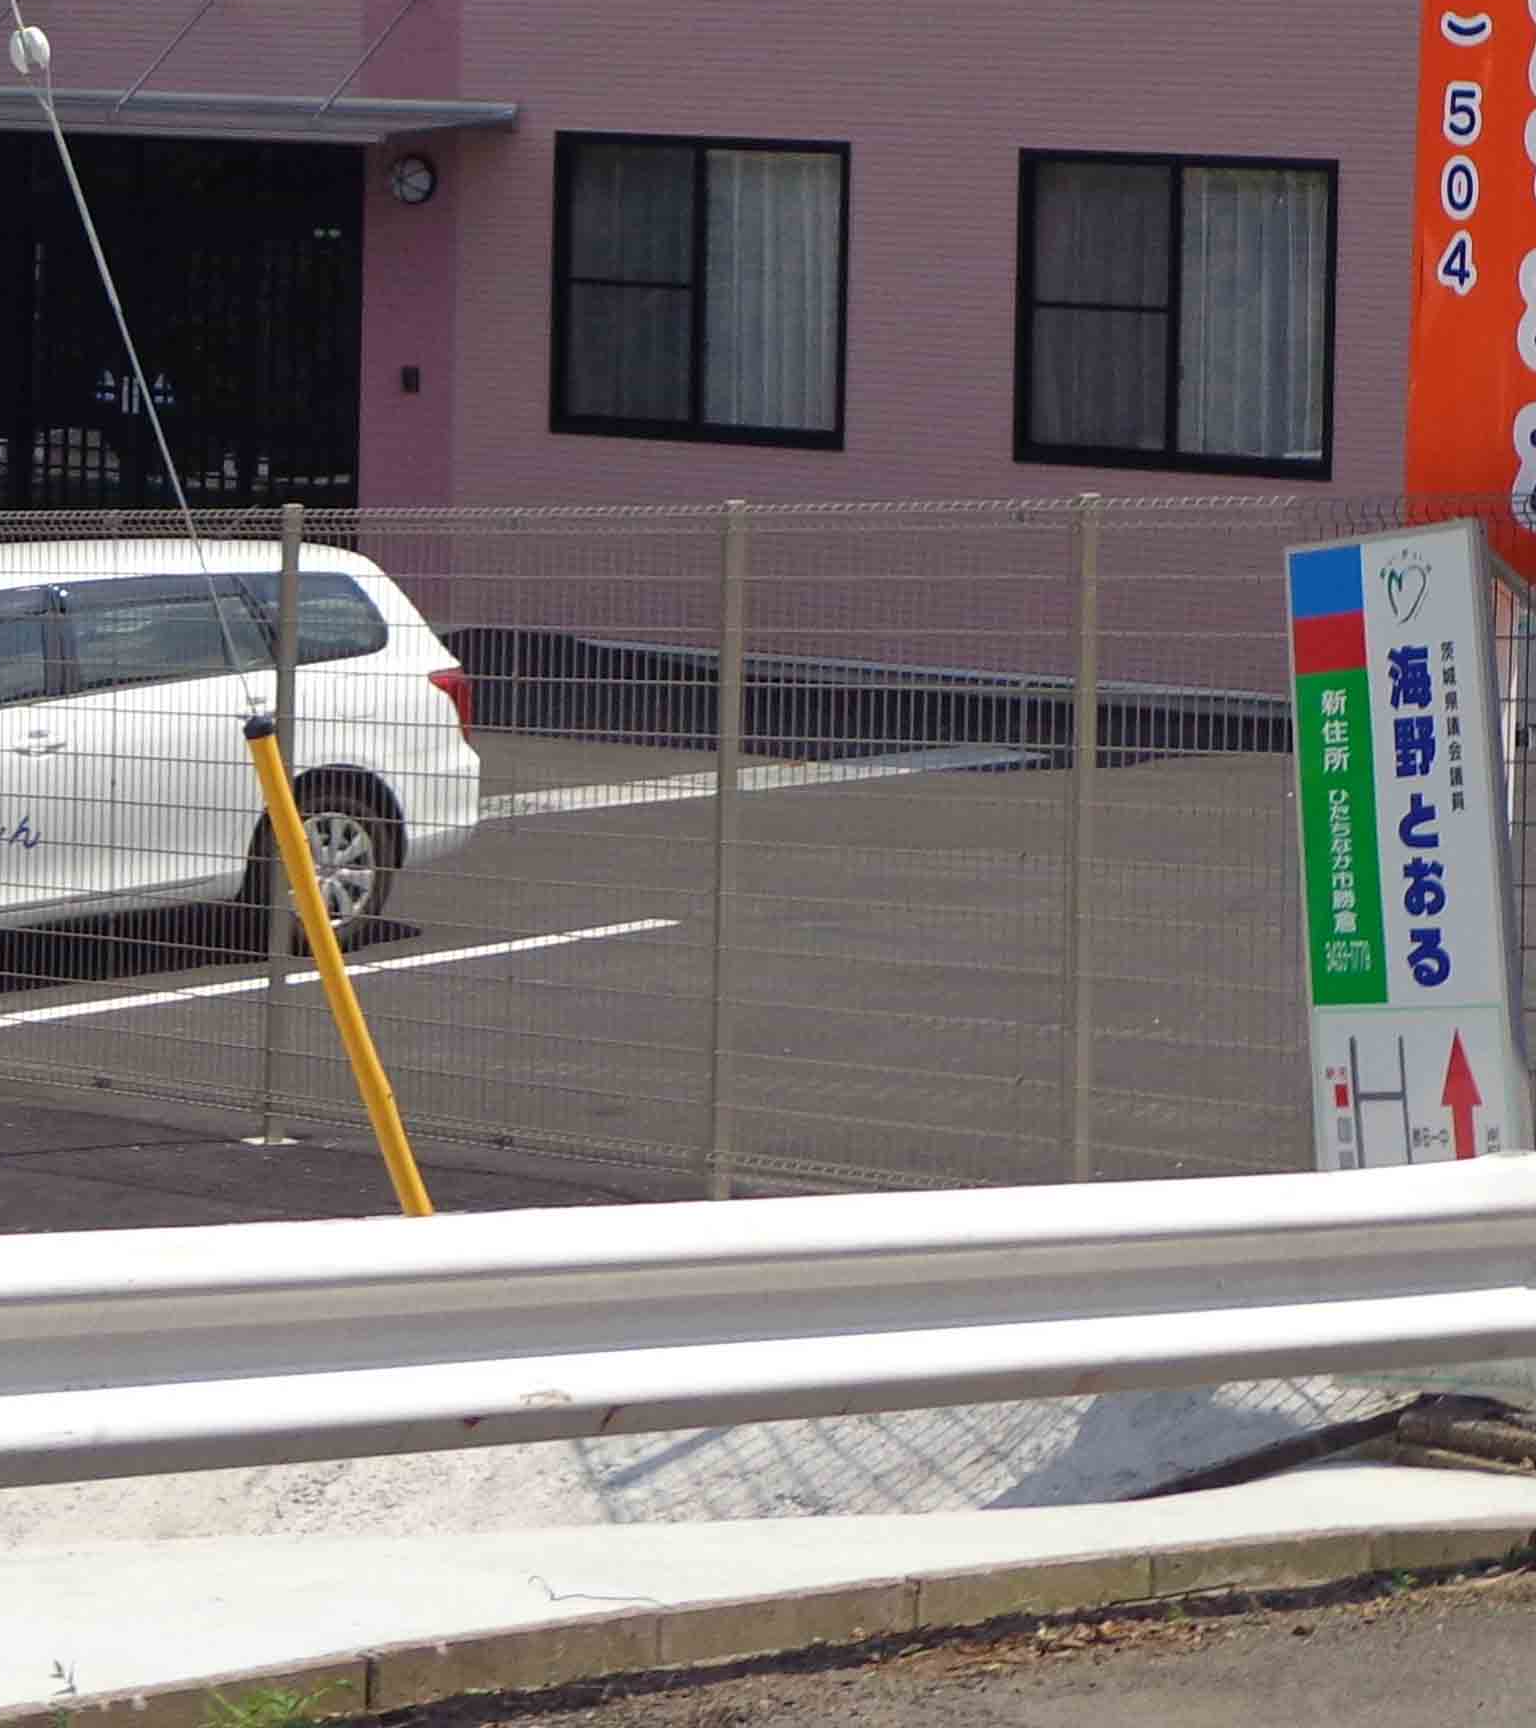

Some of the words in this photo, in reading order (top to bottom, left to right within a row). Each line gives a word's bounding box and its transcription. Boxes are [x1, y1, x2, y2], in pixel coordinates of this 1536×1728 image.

[1320, 688, 1351, 774] 新住所
[1386, 644, 1452, 988] 海野とおる
